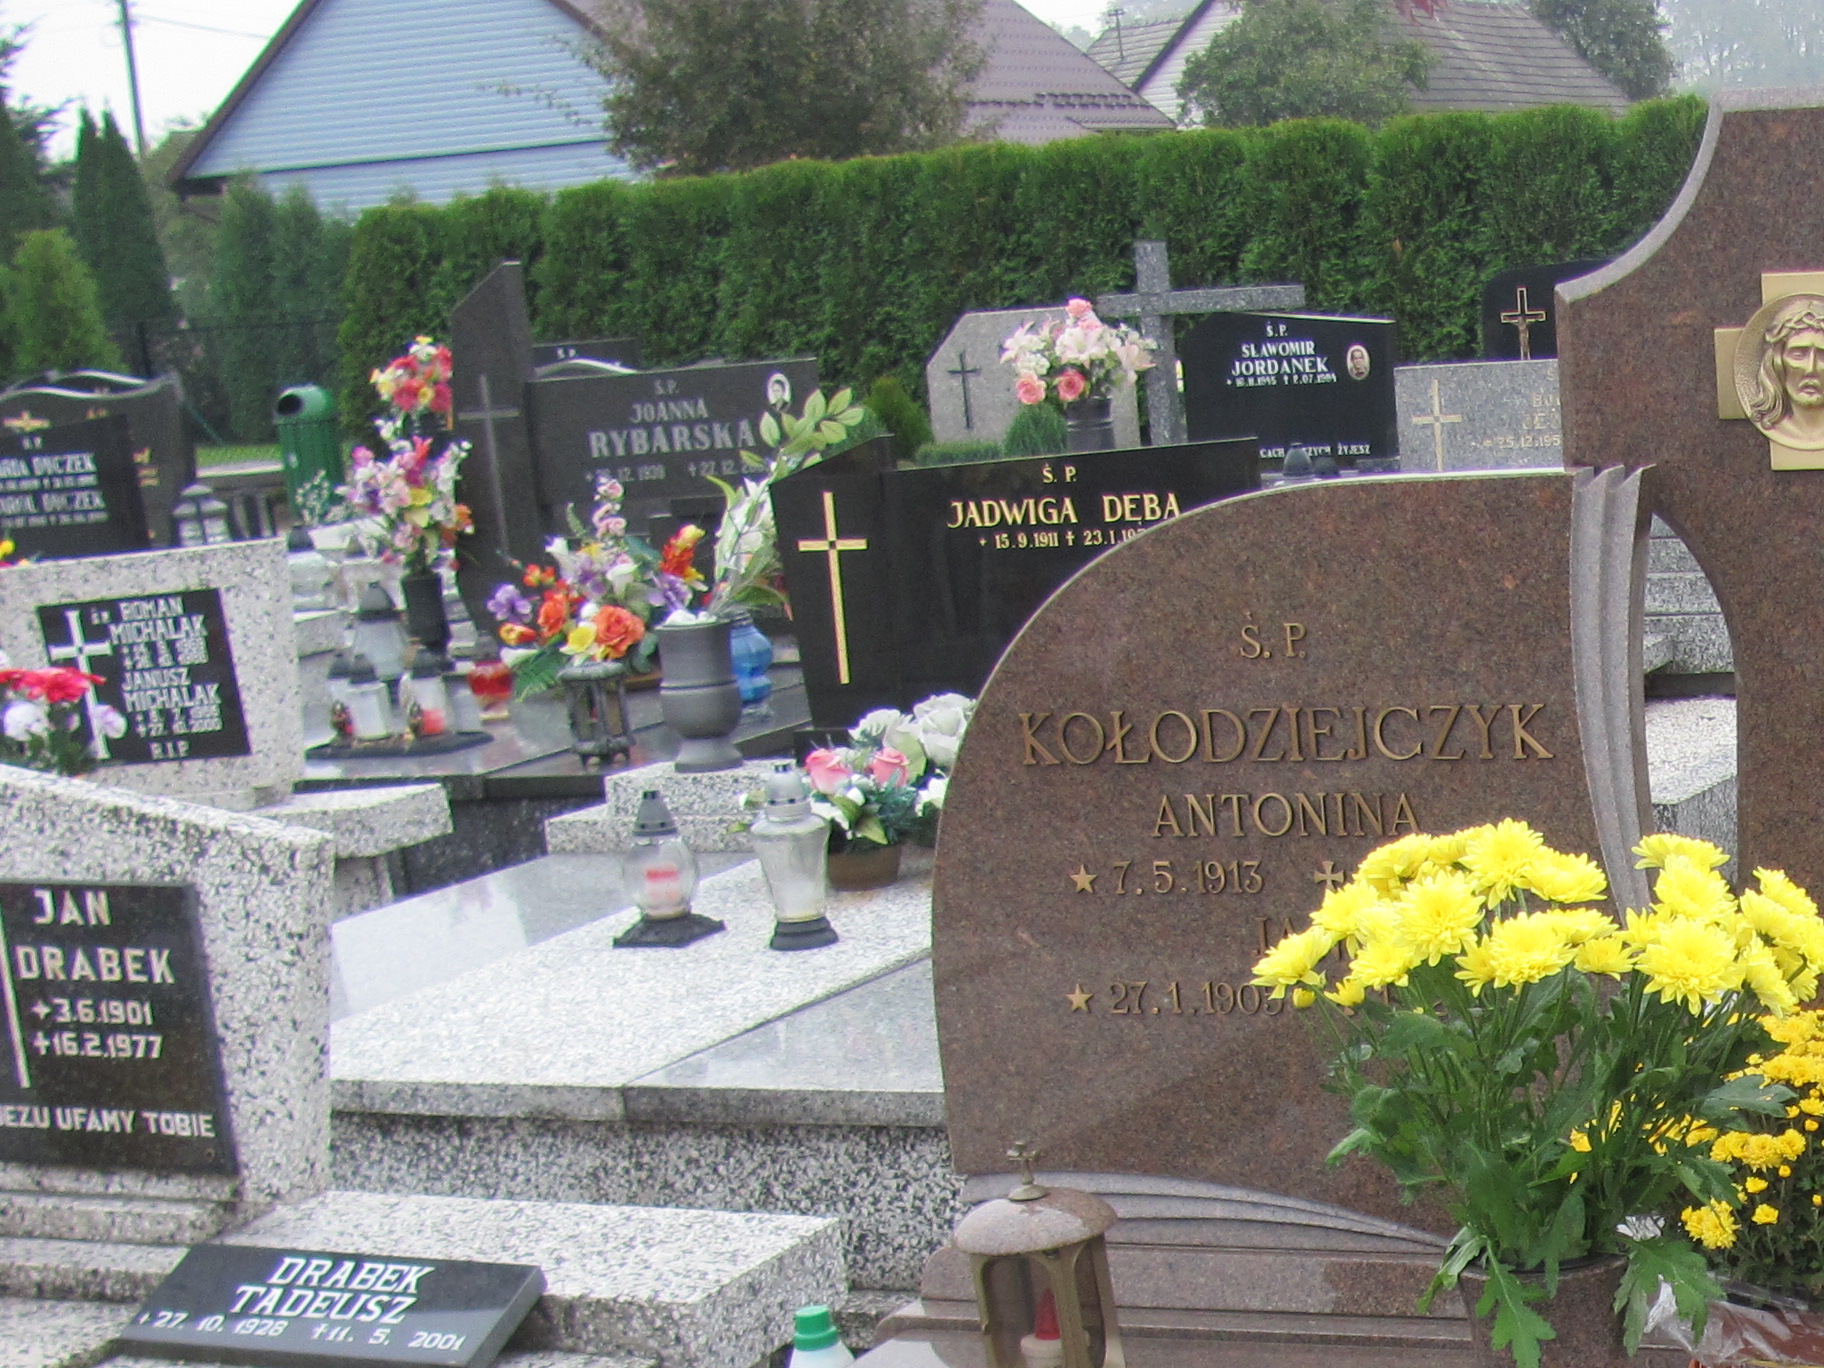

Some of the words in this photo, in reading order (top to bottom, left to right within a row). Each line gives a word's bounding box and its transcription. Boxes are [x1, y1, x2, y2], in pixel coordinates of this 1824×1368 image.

[1231, 356, 1330, 376] JORDANEK
[630, 397, 710, 424] JOANNA
[588, 418, 756, 459] RYBARSKA
[947, 496, 1079, 529] JADWIGA
[1102, 492, 1181, 526] DĘBA
[118, 595, 185, 621] ROMAN
[108, 613, 209, 645] MICHALAK
[121, 666, 192, 692] JANUSZ
[122, 682, 222, 713] MICHALAK
[1018, 702, 1555, 767] KOŁODZIEJCZYK
[1151, 792, 1421, 838] ANTONINA
[34, 887, 112, 926] JAN
[15, 944, 176, 985] DRABEK
[55, 1106, 137, 1134] UFAMY
[142, 1111, 216, 1138] TOBIE
[267, 1256, 436, 1294] DRABEK
[227, 1285, 418, 1326] TADEUSZ
[408, 1331, 466, 1352] 2001
